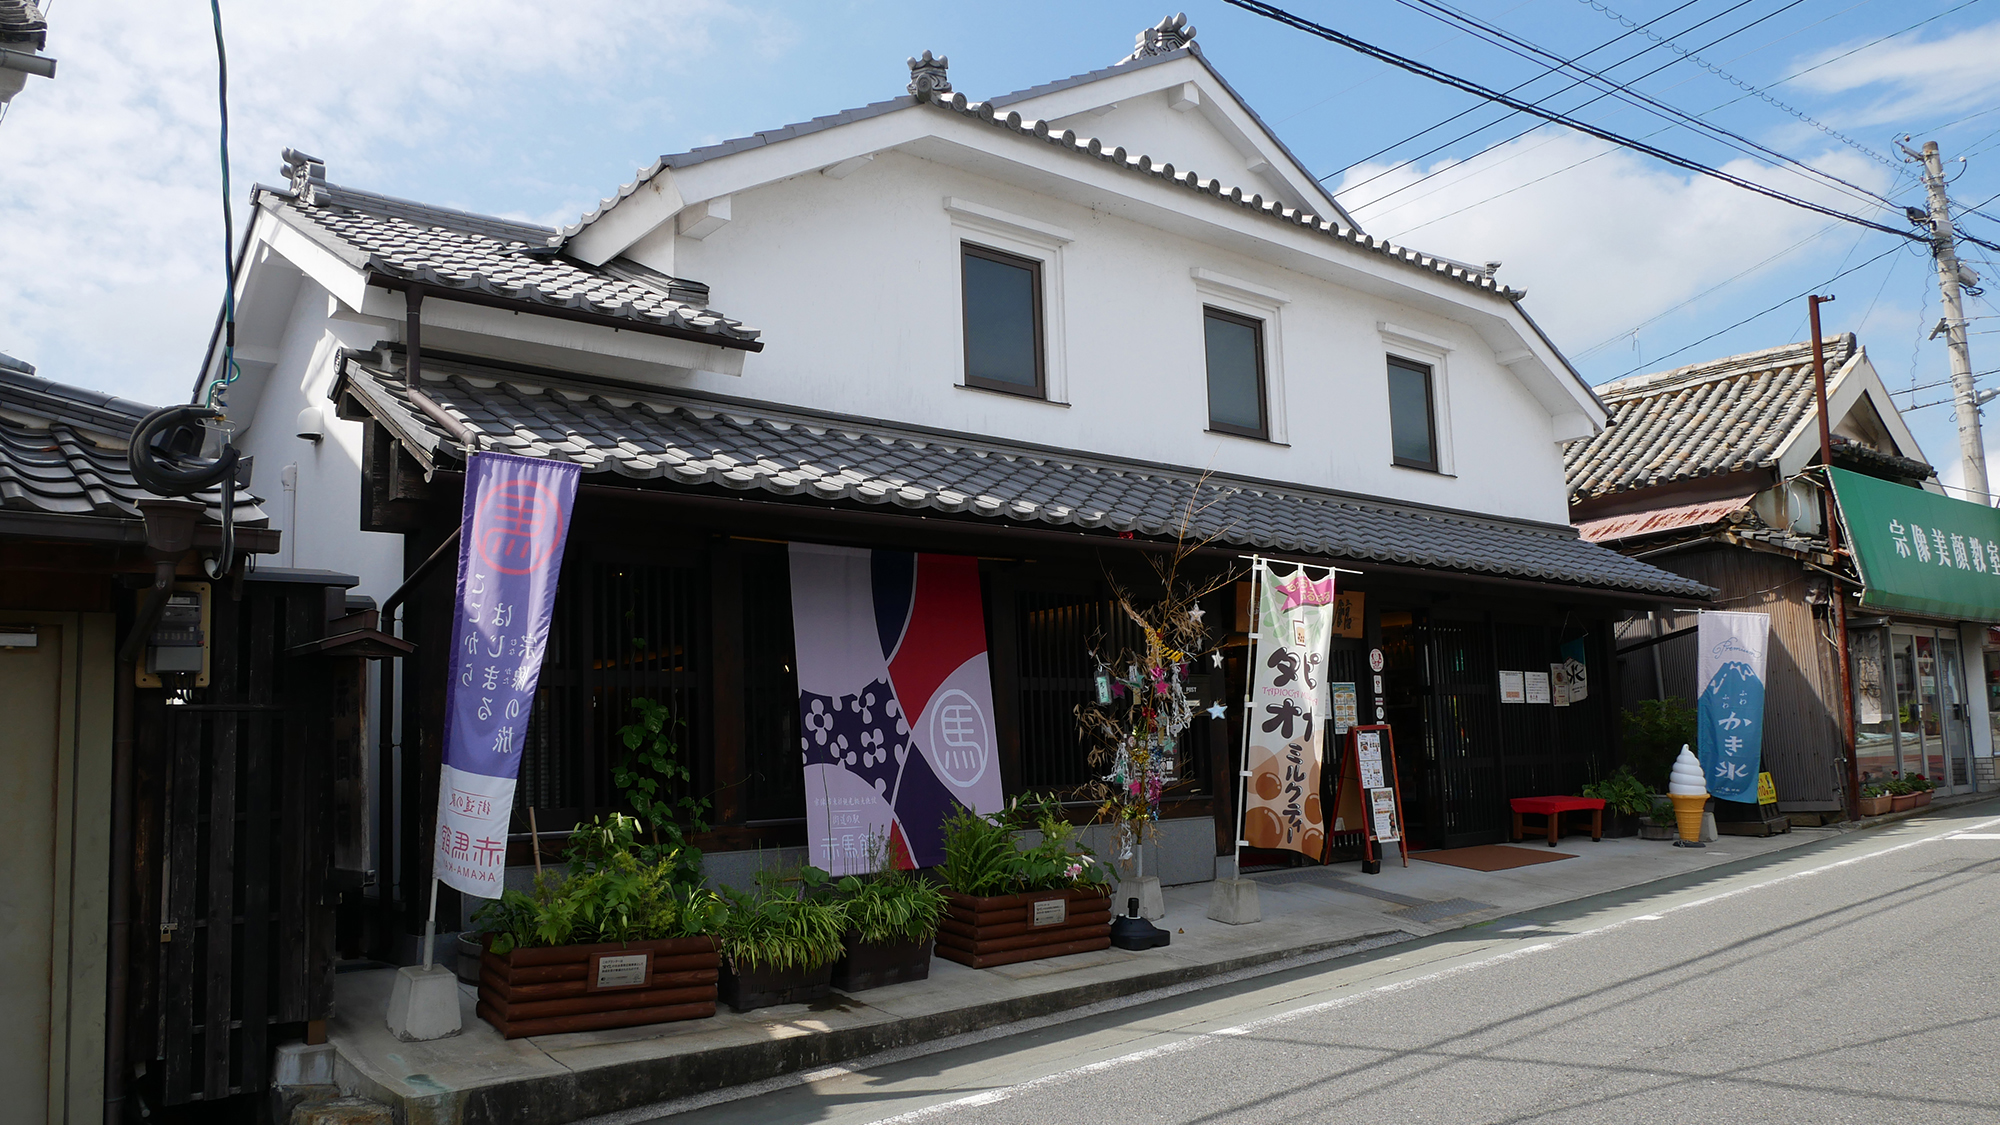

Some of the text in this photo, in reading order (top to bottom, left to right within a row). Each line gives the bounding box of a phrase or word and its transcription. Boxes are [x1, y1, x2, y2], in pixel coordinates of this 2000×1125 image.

[1889, 518, 2000, 576] 宗像美顔教室
[1712, 637, 1762, 659] Premium
[1715, 711, 1752, 781] かき氷
[1282, 742, 1306, 844] ミルクティー
